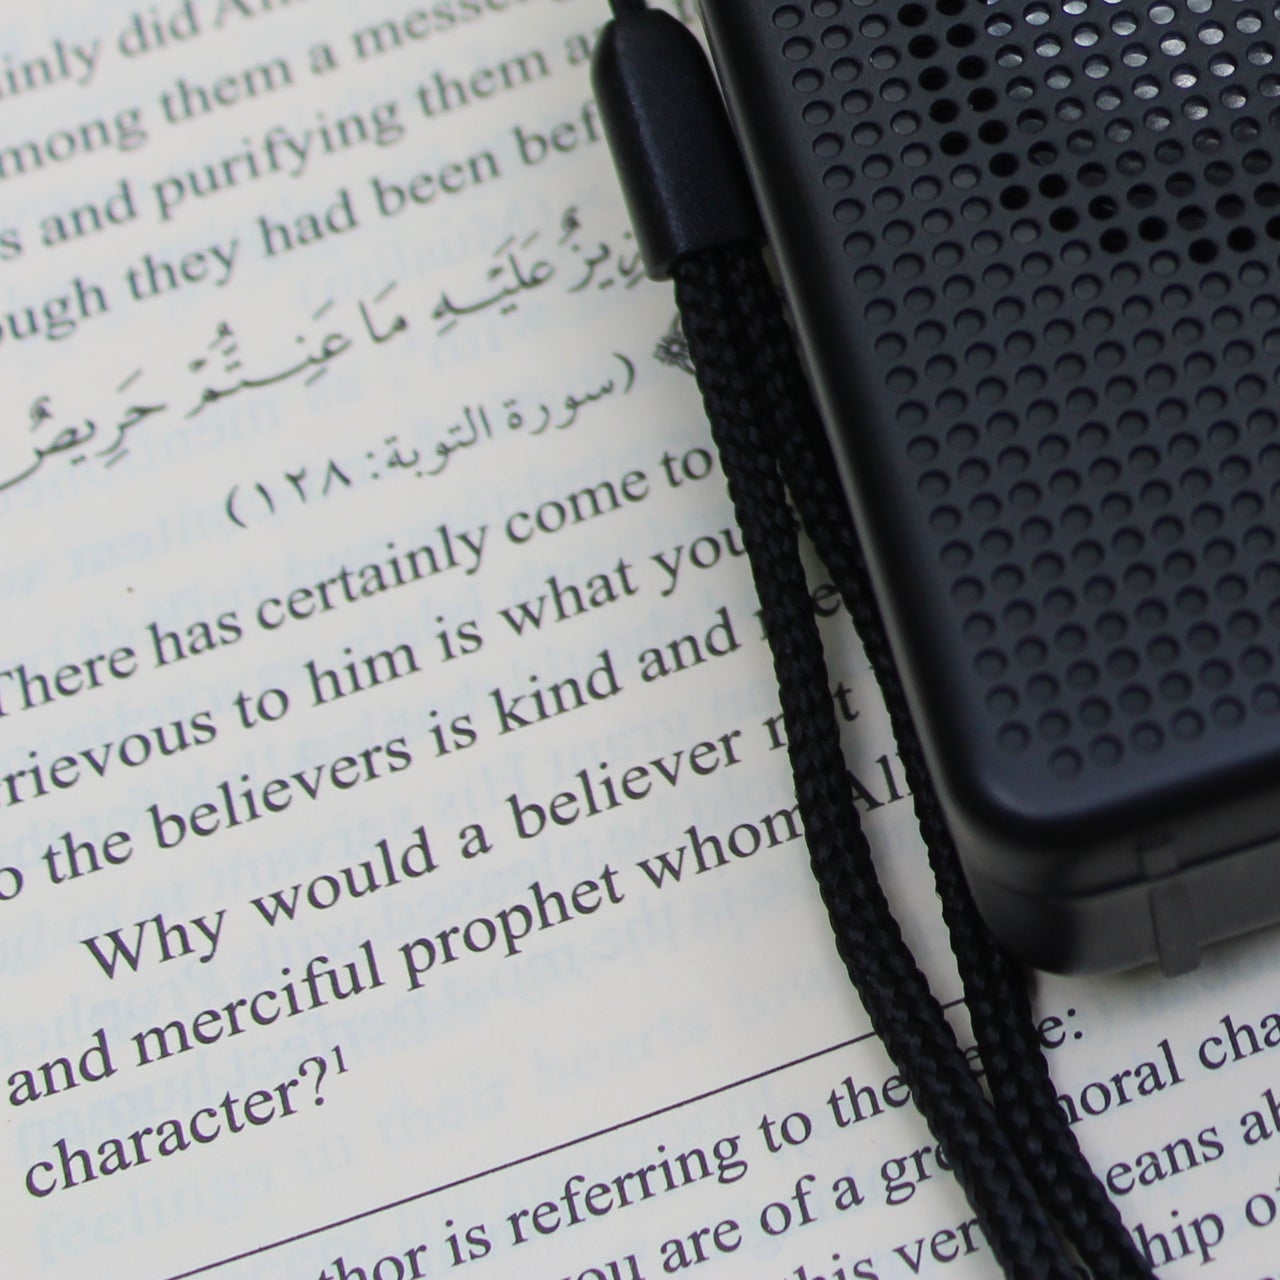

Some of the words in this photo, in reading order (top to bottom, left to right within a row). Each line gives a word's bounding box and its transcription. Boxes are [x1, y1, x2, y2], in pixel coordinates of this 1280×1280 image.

[39, 177, 140, 249] and
[150, 100, 407, 224] purifying
[414, 49, 552, 119] them
[0, 645, 138, 720] There
[145, 610, 244, 668] has
[255, 522, 488, 632] certainly
[504, 469, 650, 546] come
[659, 446, 715, 490] to
[232, 687, 291, 730] to
[302, 643, 422, 707] him
[435, 619, 484, 662] is
[497, 557, 639, 637] what
[649, 526, 747, 599] you
[5, 1026, 120, 1108] and
[129, 938, 388, 1069] merciful
[396, 862, 627, 993] prophet
[634, 804, 805, 890] whom
[78, 907, 228, 981] Why
[248, 824, 441, 928] would
[457, 822, 494, 861] a
[504, 728, 743, 840] believer
